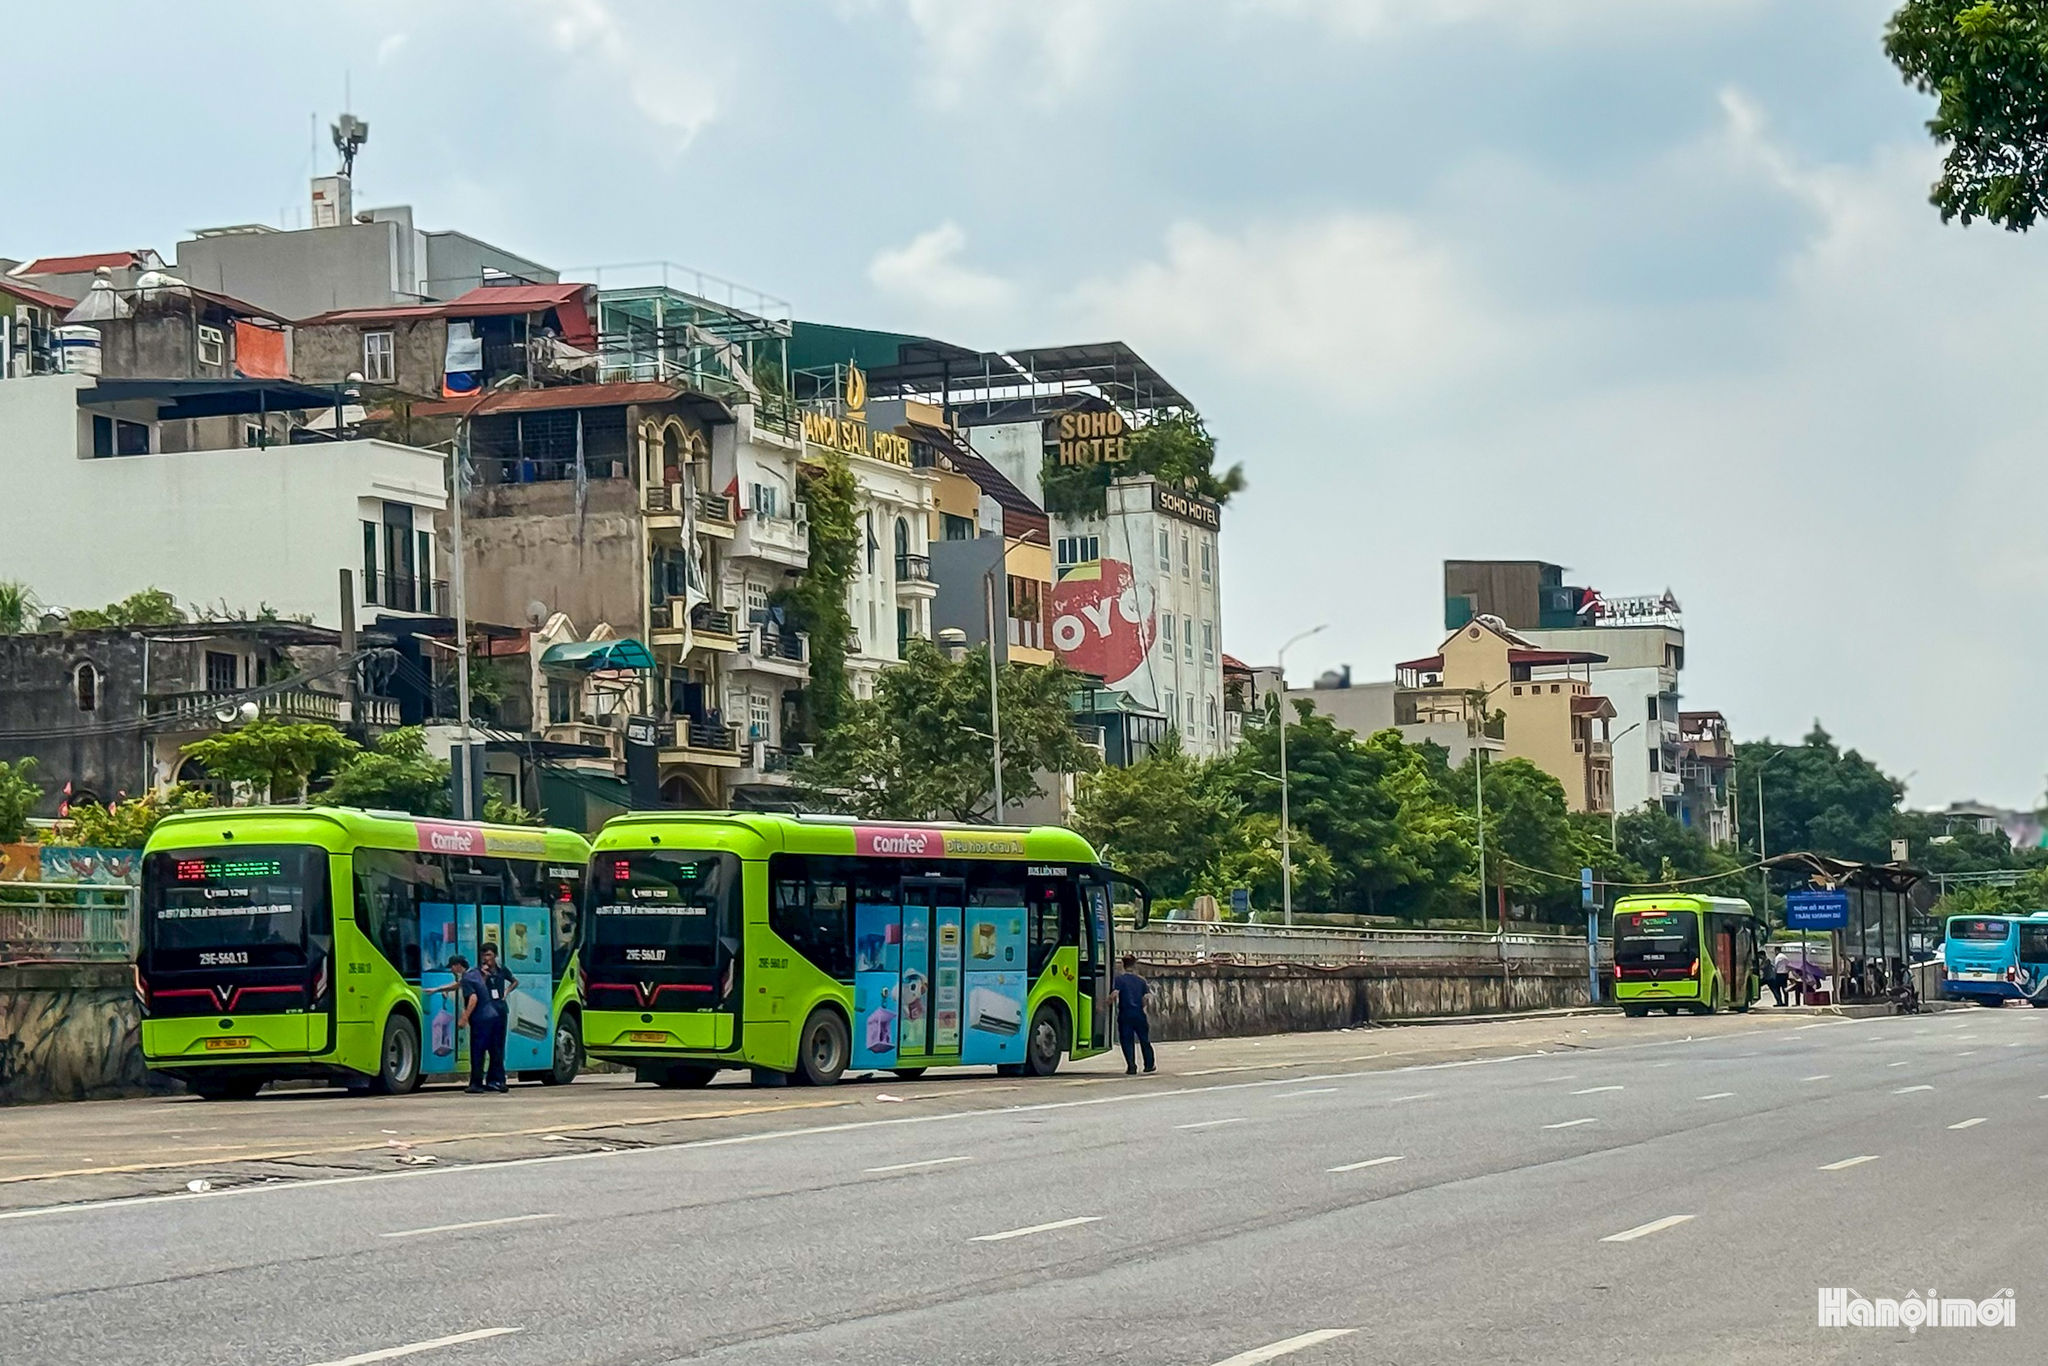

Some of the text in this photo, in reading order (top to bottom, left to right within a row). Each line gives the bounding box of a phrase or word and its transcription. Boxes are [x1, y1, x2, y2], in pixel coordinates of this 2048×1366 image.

[801, 408, 913, 468] ANOI SAIL HOTEL
[1060, 411, 1123, 439] SOHO
[1059, 438, 1131, 466] HOTEL
[1160, 492, 1218, 526] SOHO HOTEL
[1052, 586, 1154, 652] OYO
[199, 952, 249, 965] 29E-560.13
